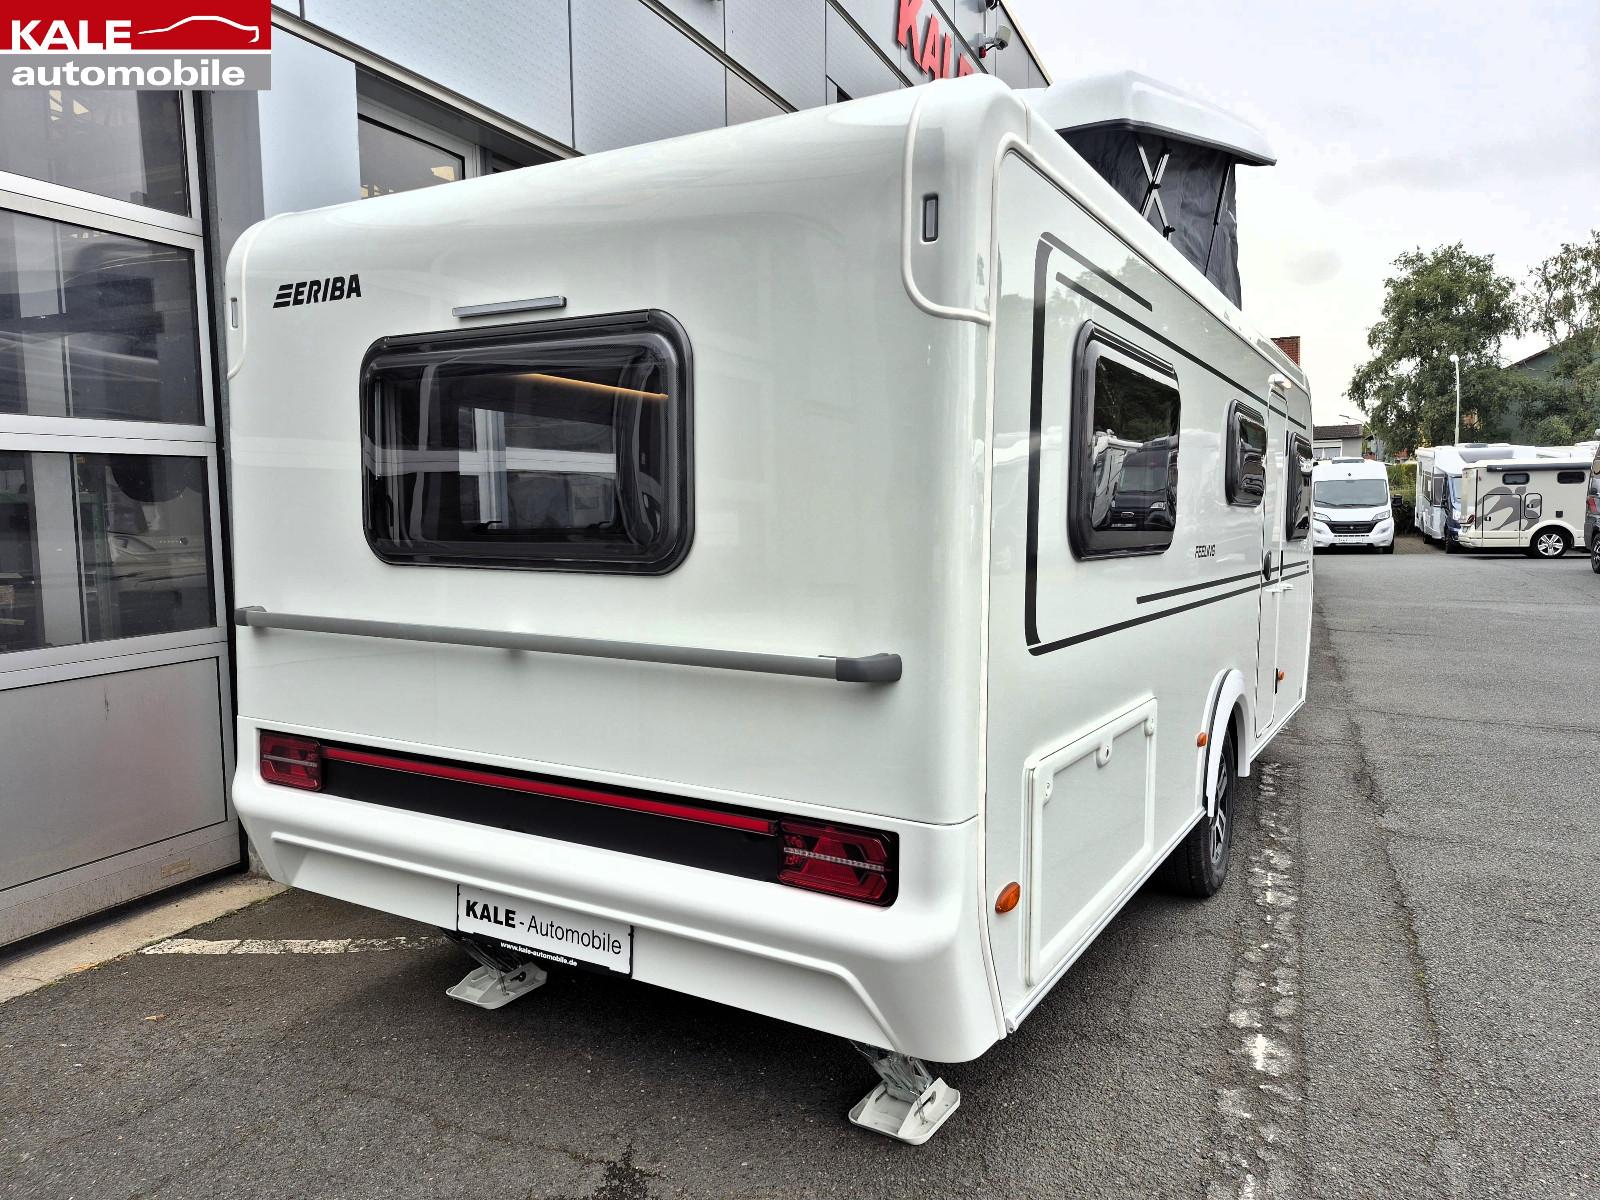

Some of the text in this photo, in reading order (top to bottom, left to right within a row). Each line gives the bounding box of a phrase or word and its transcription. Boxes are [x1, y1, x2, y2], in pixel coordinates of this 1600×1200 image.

[291, 273, 362, 307] ERIBA
[465, 899, 516, 929] KALE
[527, 915, 622, 955] Automobile
[500, 941, 579, 967] www.kale-automobile.de
